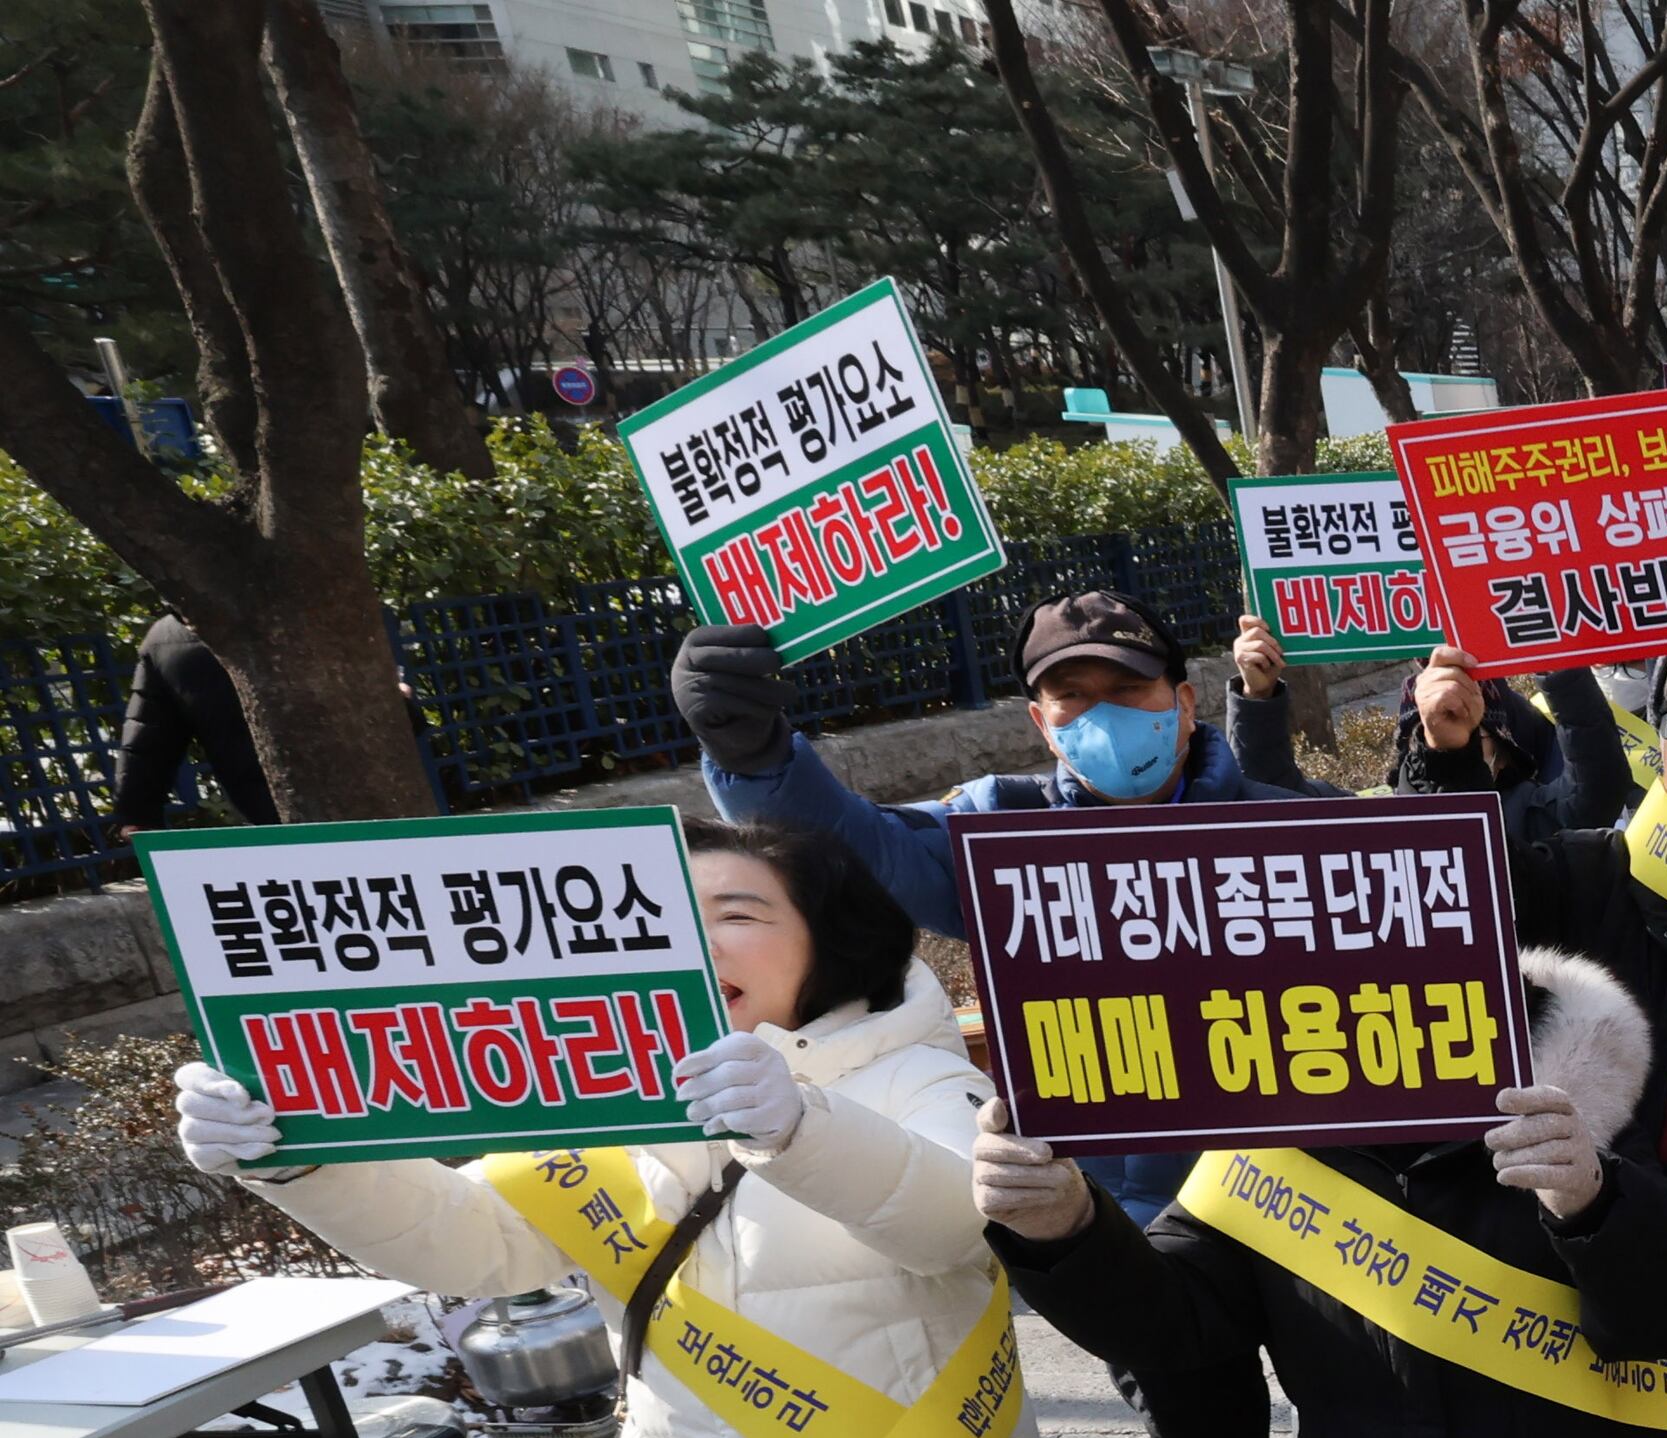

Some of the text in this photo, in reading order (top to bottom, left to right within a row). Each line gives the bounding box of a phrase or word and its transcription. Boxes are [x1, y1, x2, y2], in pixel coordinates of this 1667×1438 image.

[660, 340, 916, 526] 불확정적 평가요소
[1425, 434, 1630, 498] 피해주주권리,
[702, 444, 962, 628] 배제하라!
[1262, 501, 1382, 559] 불확정적
[1438, 499, 1581, 568] 금융위
[203, 863, 672, 978] 불확정적 평가요소
[993, 845, 1474, 963] 거래 정지 종목 단계적
[240, 989, 692, 1119] 배제하라!
[1022, 981, 1499, 1104] 매매 허용하라
[578, 1186, 648, 1266] 폐지
[1220, 1153, 1584, 1366] 금융위 상장 폐지 정책
[676, 1319, 830, 1433] 보완하라
